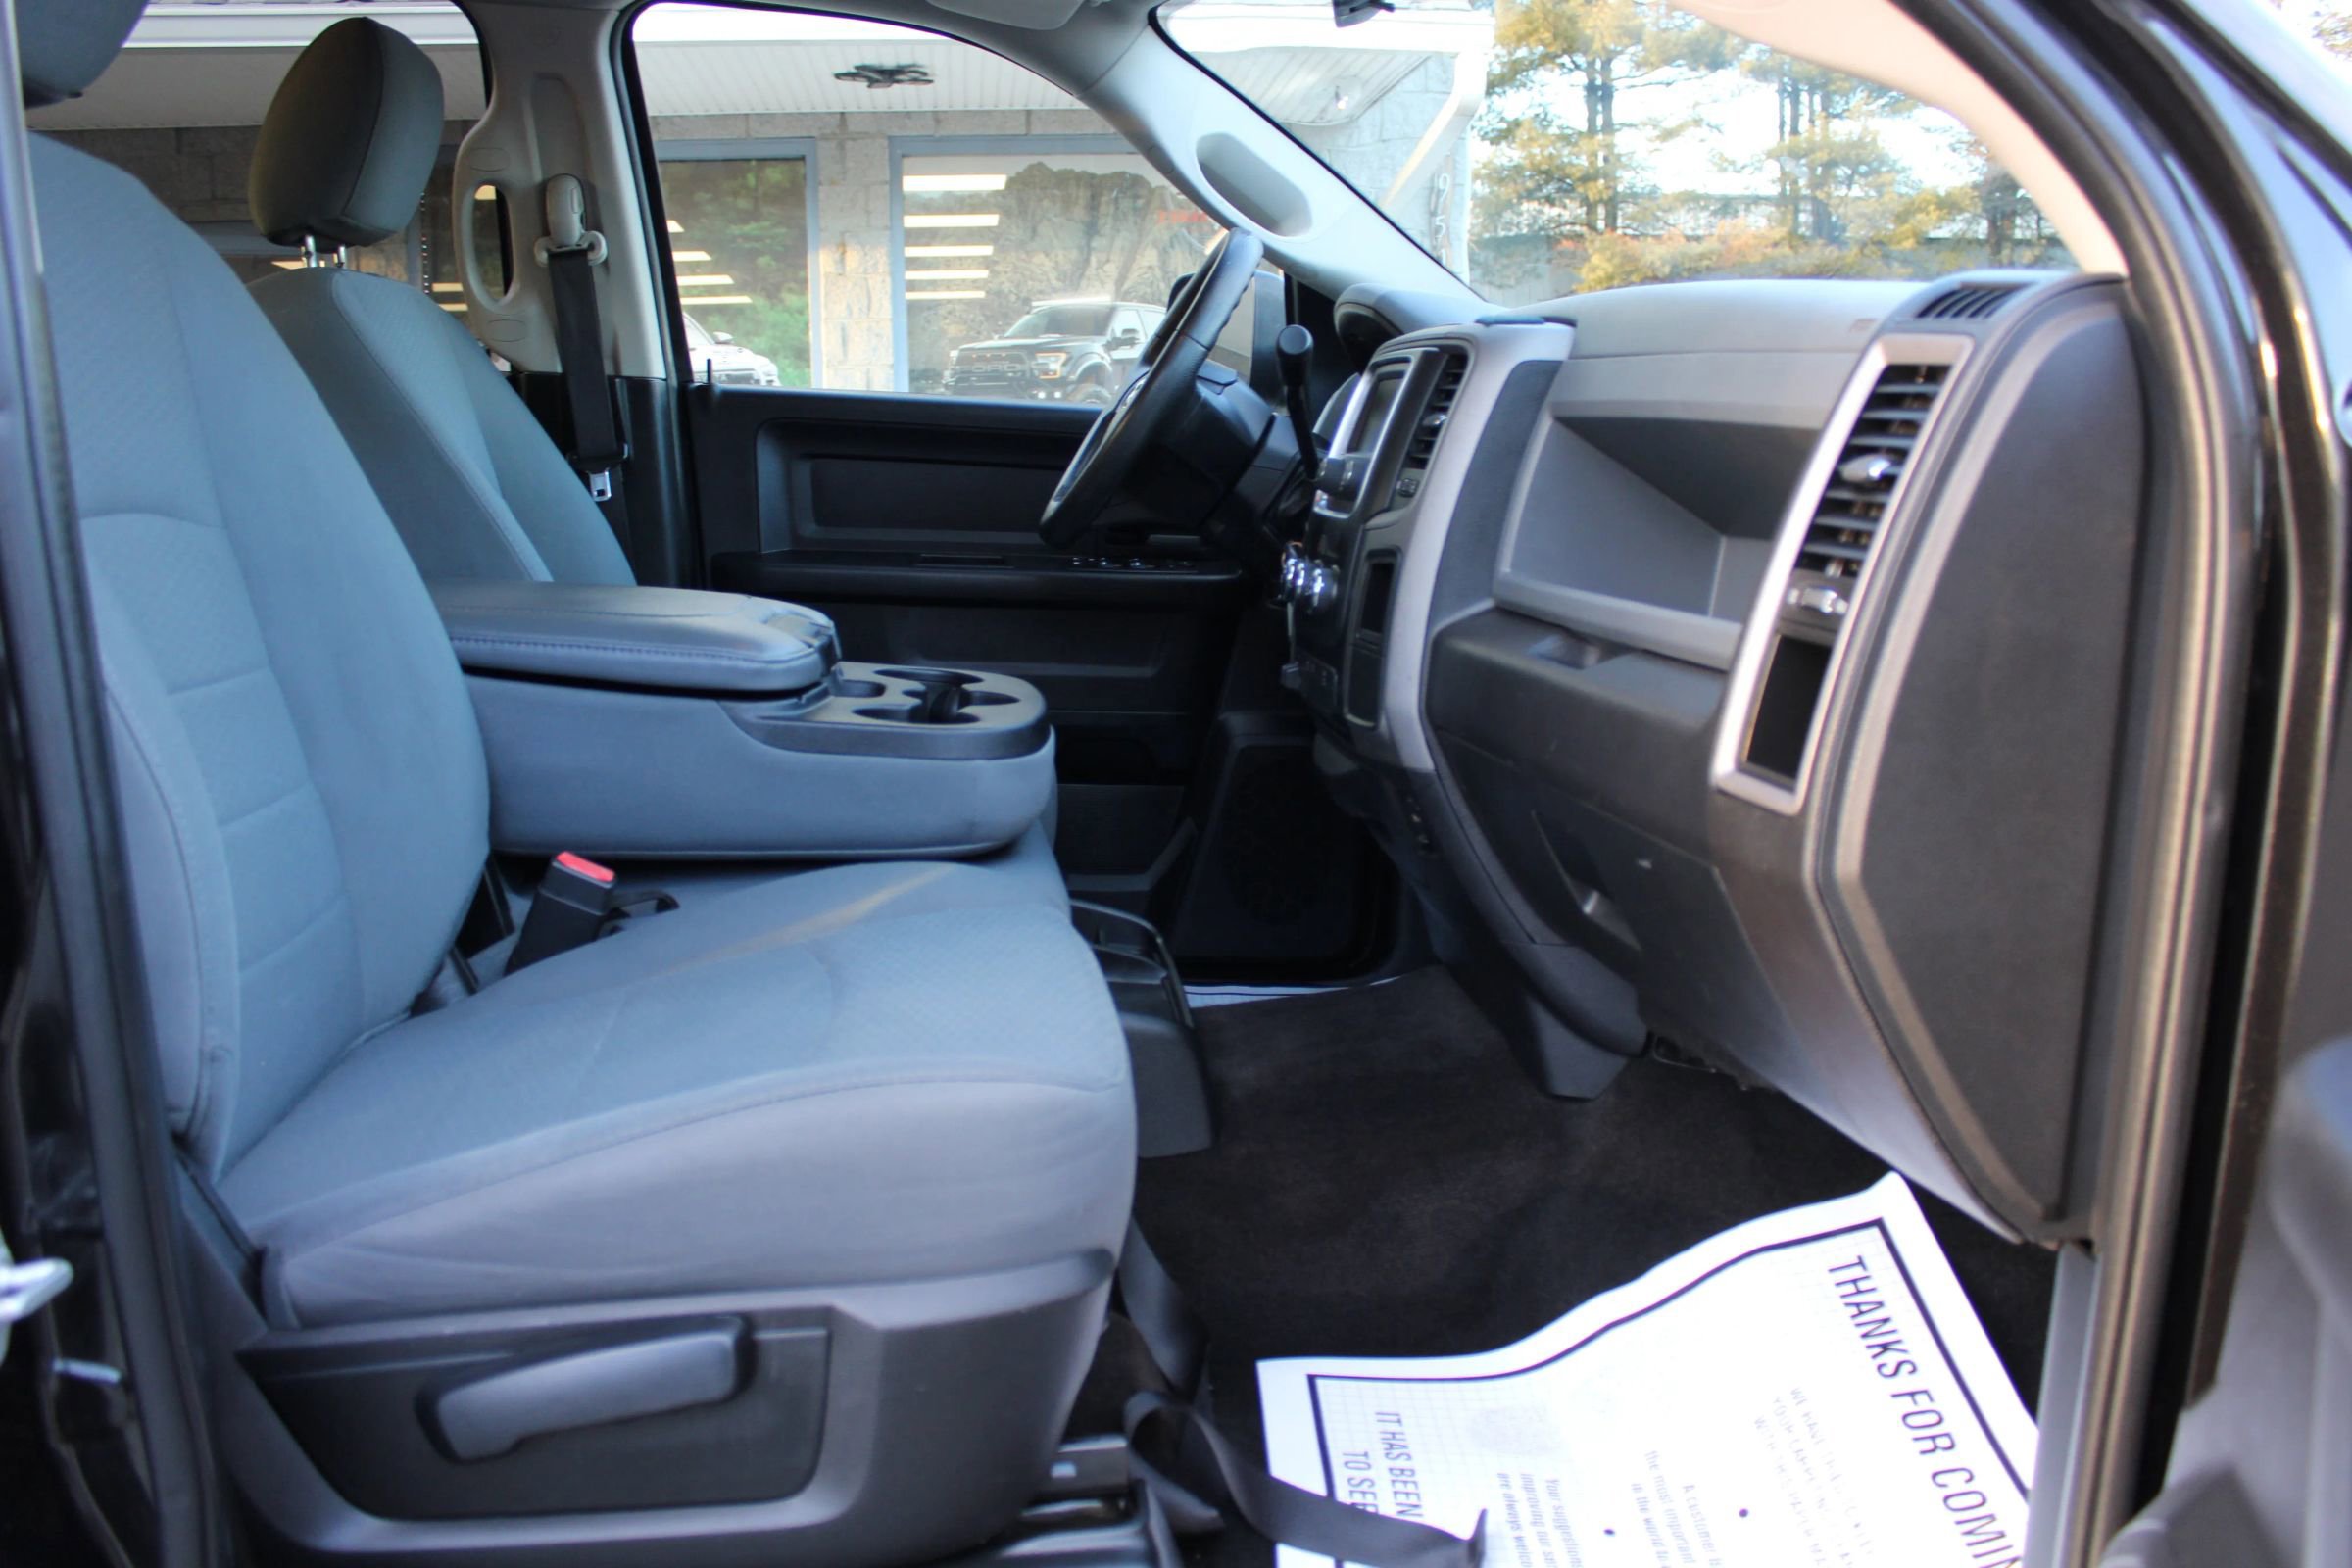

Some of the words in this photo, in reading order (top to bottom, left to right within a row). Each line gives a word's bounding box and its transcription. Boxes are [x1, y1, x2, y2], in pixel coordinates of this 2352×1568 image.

[1828, 1255, 1917, 1379] THANKS
[1890, 1389, 1956, 1455] FOR
[1375, 1411, 1402, 1427] IT
[1342, 1450, 1372, 1471] TO
[1379, 1430, 1412, 1461] HAS
[1388, 1467, 1424, 1518] BEEN
[1496, 1472, 1512, 1490] are
[1544, 1478, 1561, 1501] Your
[1501, 1492, 1523, 1532] always
[1520, 1473, 1546, 1527] improving
[1536, 1531, 1552, 1547] our
[1644, 1449, 1660, 1471] the
[1653, 1475, 1674, 1504] most
[1664, 1508, 1697, 1564] important
